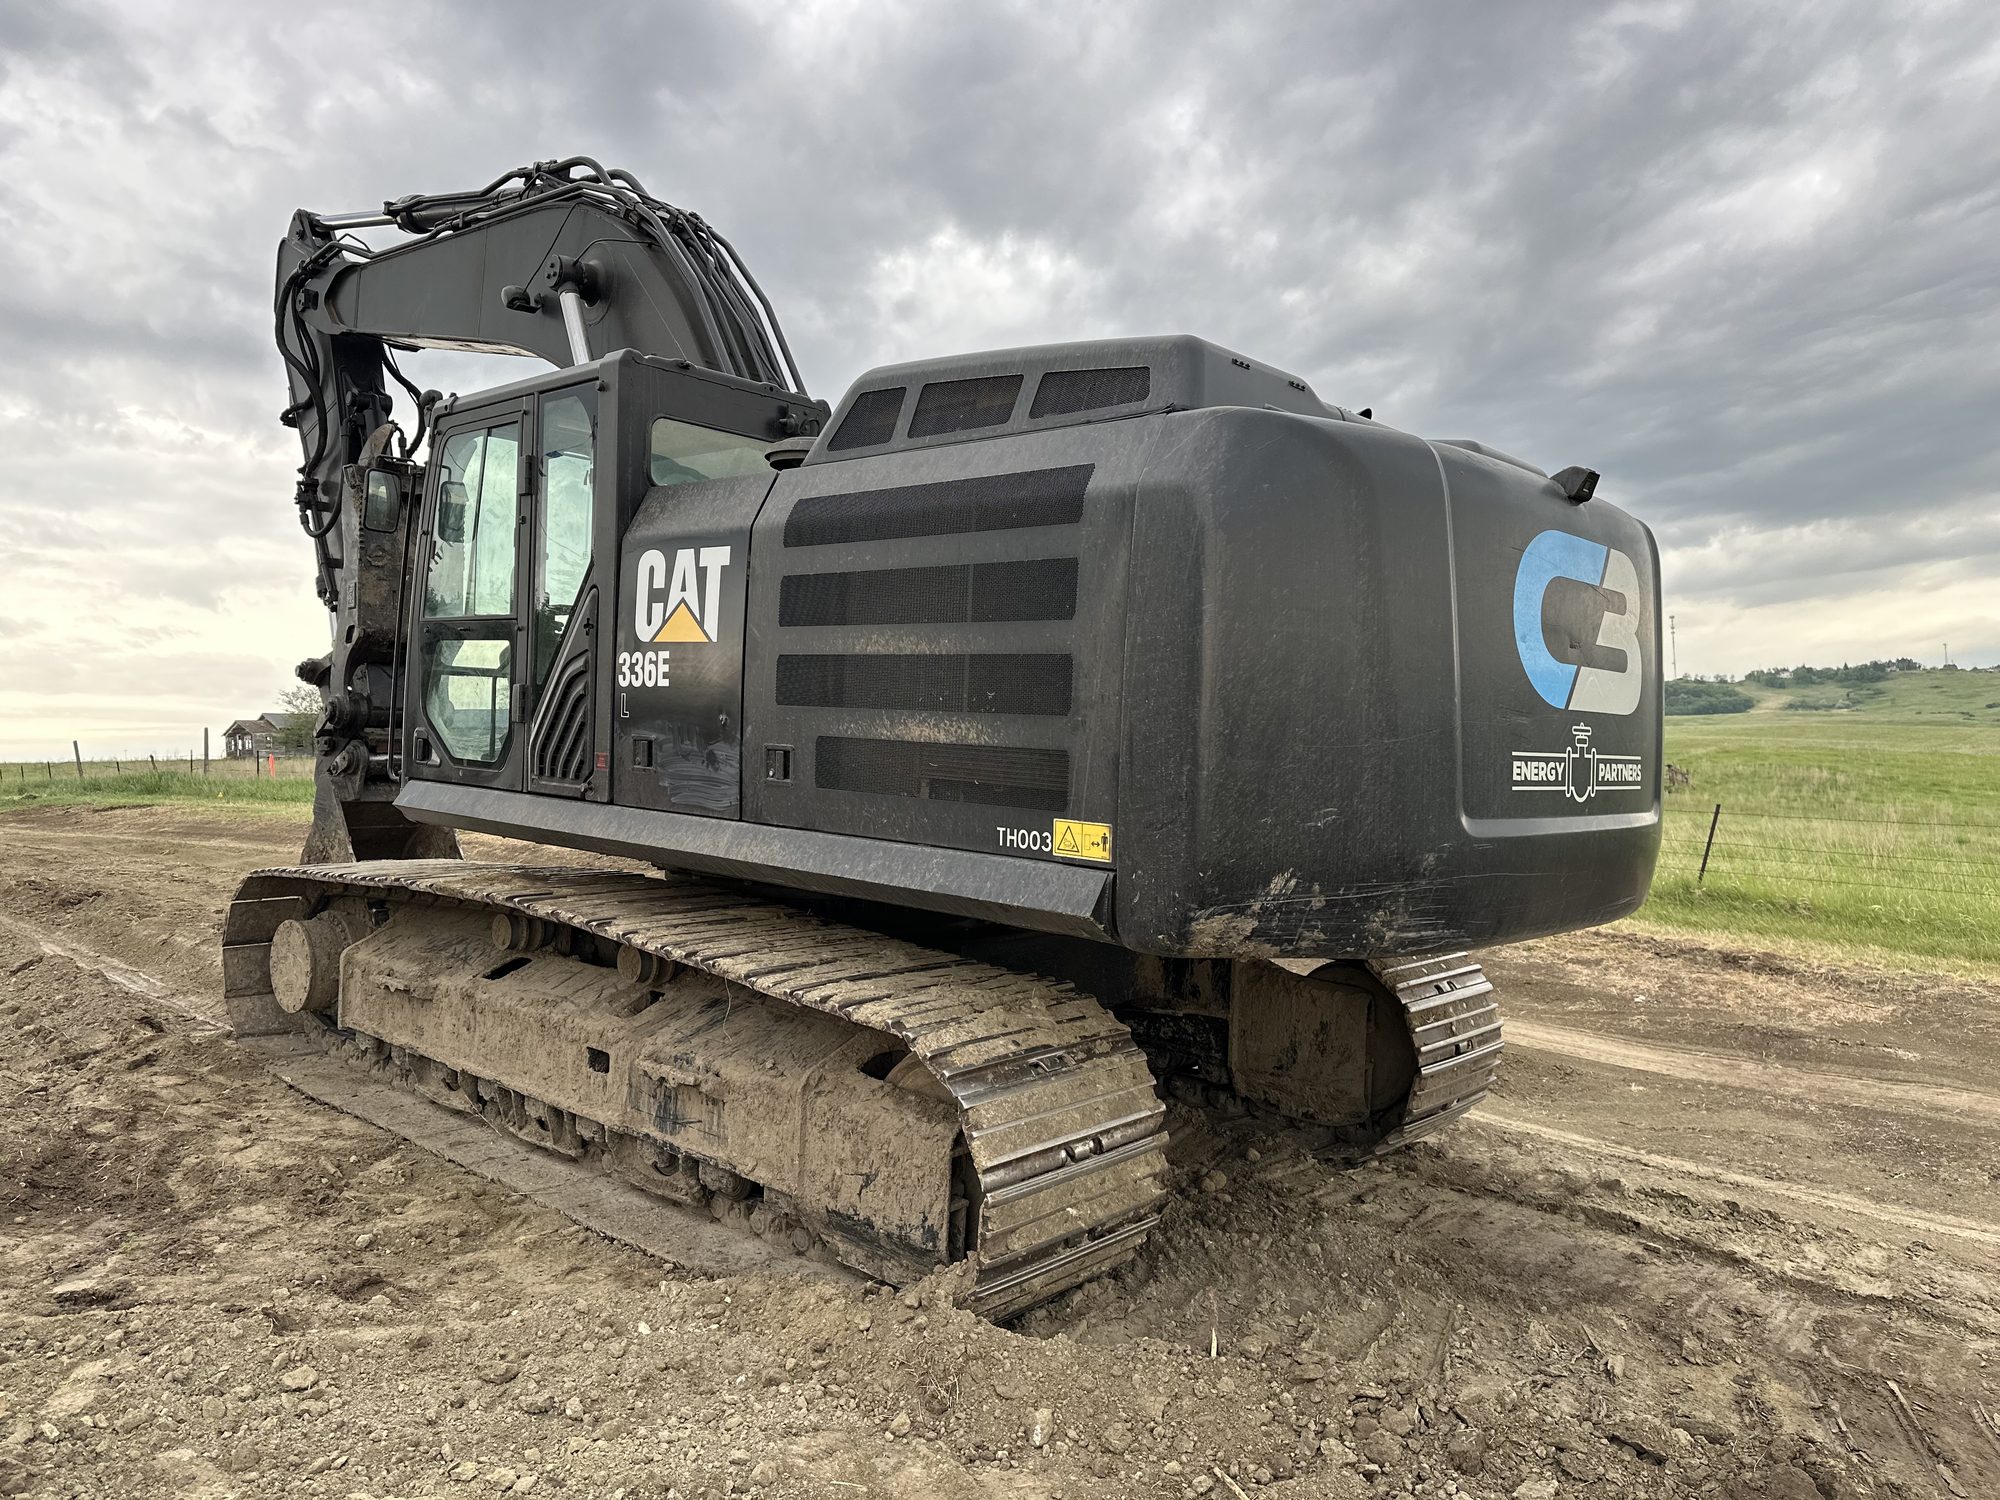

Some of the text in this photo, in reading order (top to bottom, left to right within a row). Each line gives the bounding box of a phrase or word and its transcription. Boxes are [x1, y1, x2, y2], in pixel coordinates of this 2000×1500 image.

[635, 546, 731, 643] CAT
[1513, 530, 1642, 715] C3
[618, 651, 670, 687] 336E
[621, 693, 630, 718] L
[1512, 761, 1642, 782] ENERGY PARTNERS
